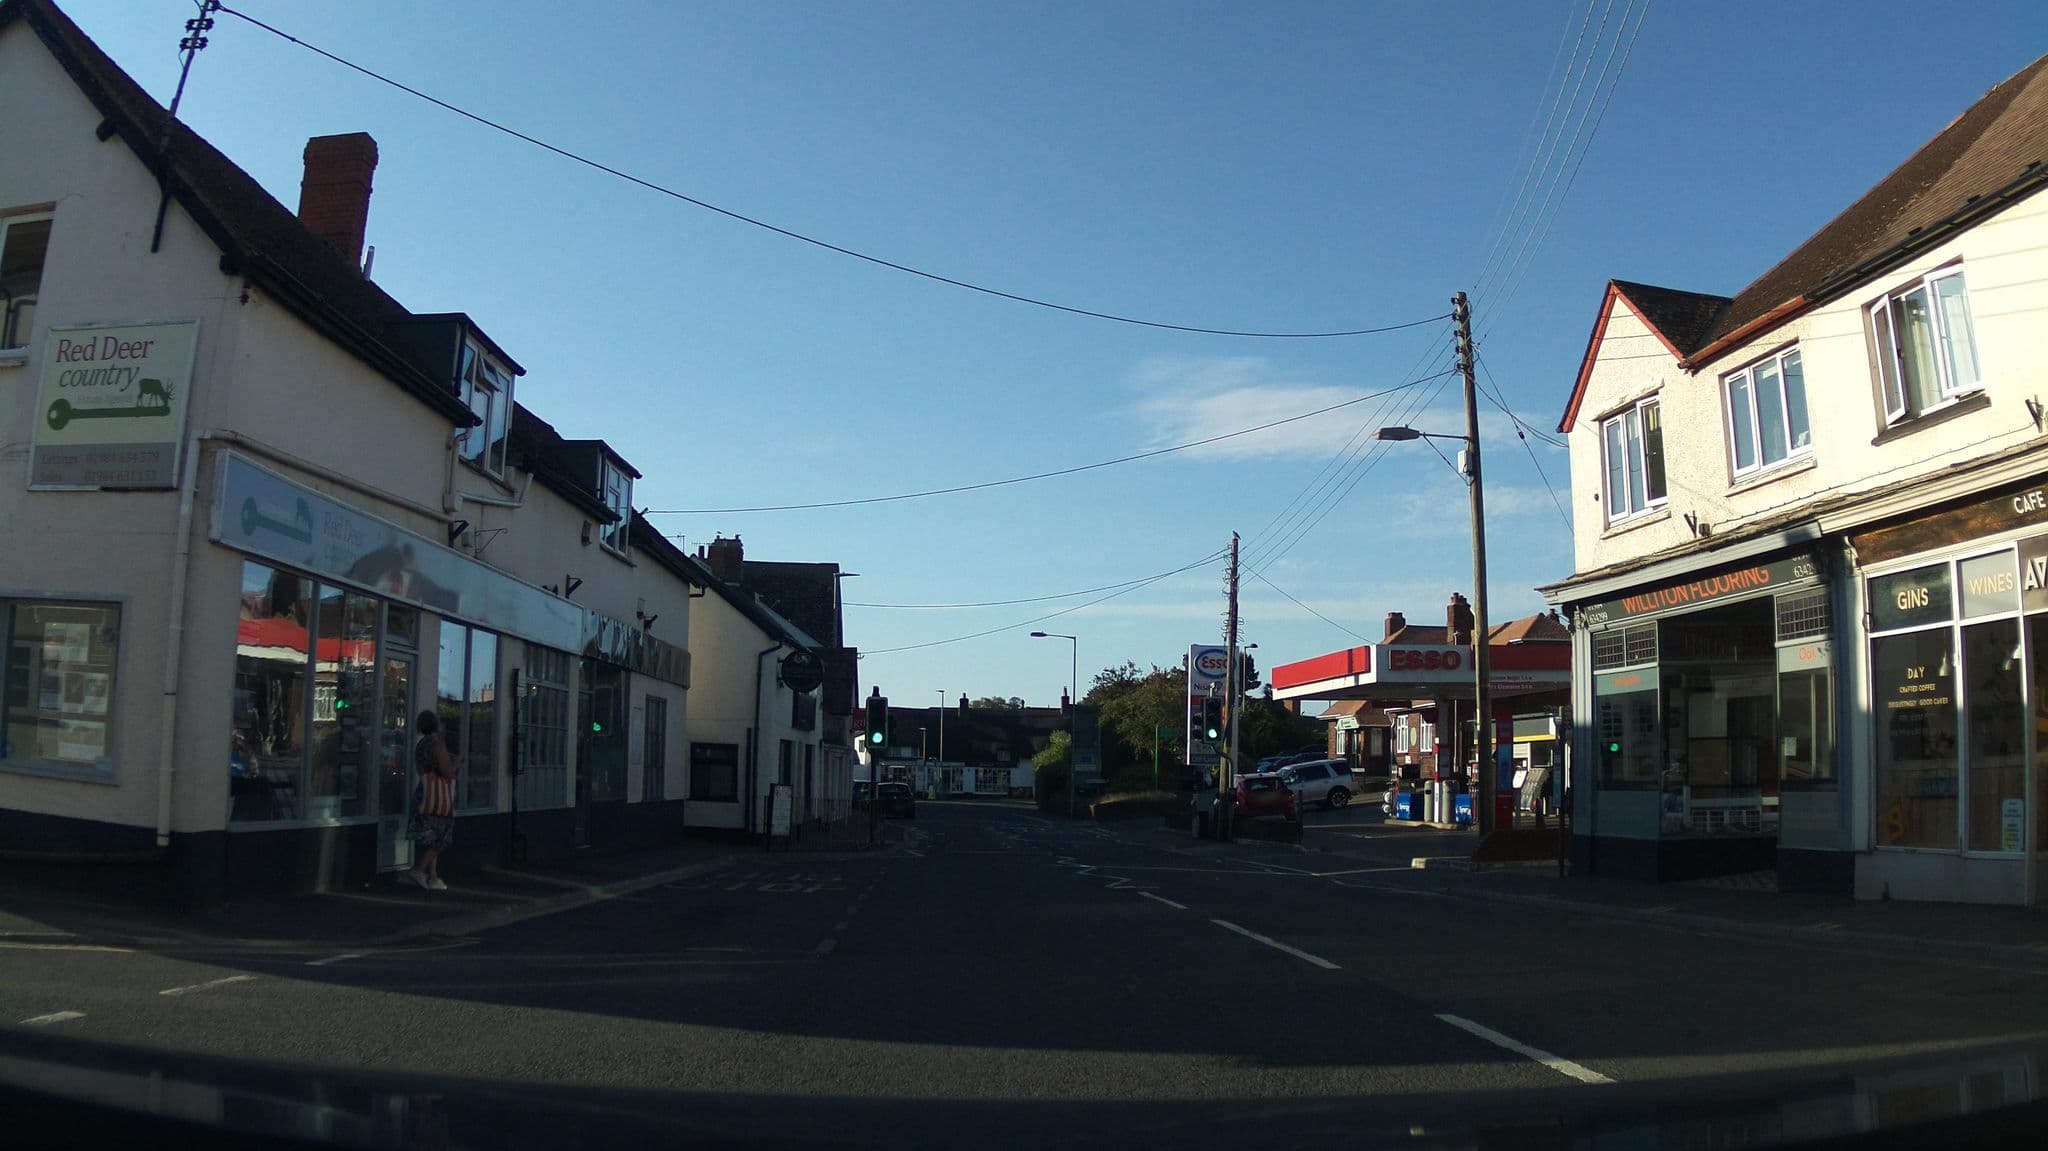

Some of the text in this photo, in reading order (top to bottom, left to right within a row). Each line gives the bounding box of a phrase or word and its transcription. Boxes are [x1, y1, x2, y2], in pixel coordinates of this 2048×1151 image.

[56, 335, 154, 362] Red Deer
[59, 364, 140, 392] country
[2013, 490, 2046, 514] CAFE
[1622, 566, 1770, 614] WILLITON FLOORING
[1969, 573, 2014, 596] WINES
[1897, 587, 1929, 610] GINS
[1388, 650, 1461, 671] ESSO
[1907, 666, 1925, 680] DAY
[1918, 683, 1937, 692] COFFEE
